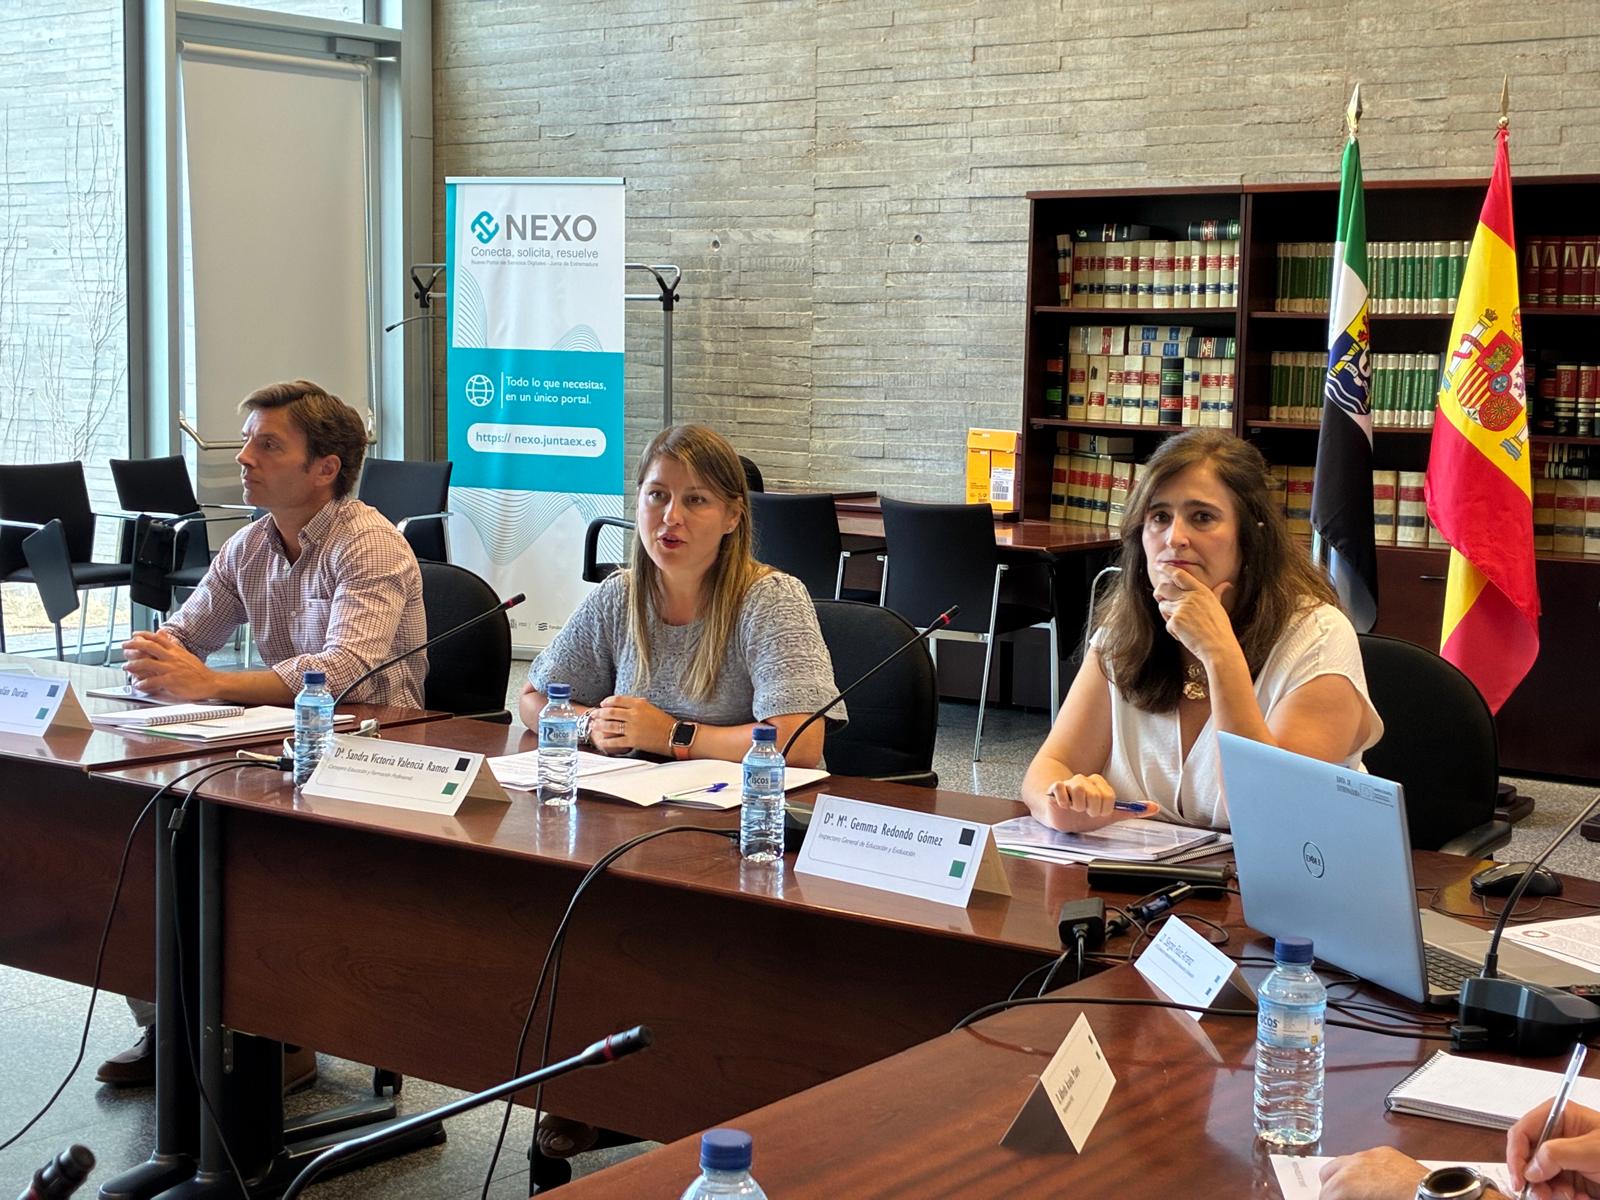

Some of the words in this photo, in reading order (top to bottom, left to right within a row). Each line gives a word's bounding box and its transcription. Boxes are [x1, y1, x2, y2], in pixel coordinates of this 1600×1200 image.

[506, 214, 597, 242] NEXO
[471, 246, 514, 258] Conecta,
[517, 247, 553, 259] solicita,
[556, 248, 599, 259] resuelve
[505, 376, 529, 387] Todo
[531, 377, 541, 387] lo
[543, 380, 560, 390] que
[562, 380, 607, 391] necesitas,
[505, 393, 516, 401] en
[534, 392, 559, 402] único
[561, 394, 592, 405] portal.
[475, 432, 511, 445] https://
[514, 434, 597, 447] nexo.juntaex.es
[345, 749, 369, 762] Sandra
[370, 753, 396, 766] Victoria
[396, 757, 425, 770] Valencia
[426, 761, 450, 774] Ramos
[850, 817, 878, 834] Gemma
[881, 823, 914, 841] Redondo
[917, 829, 943, 847] Gómez
